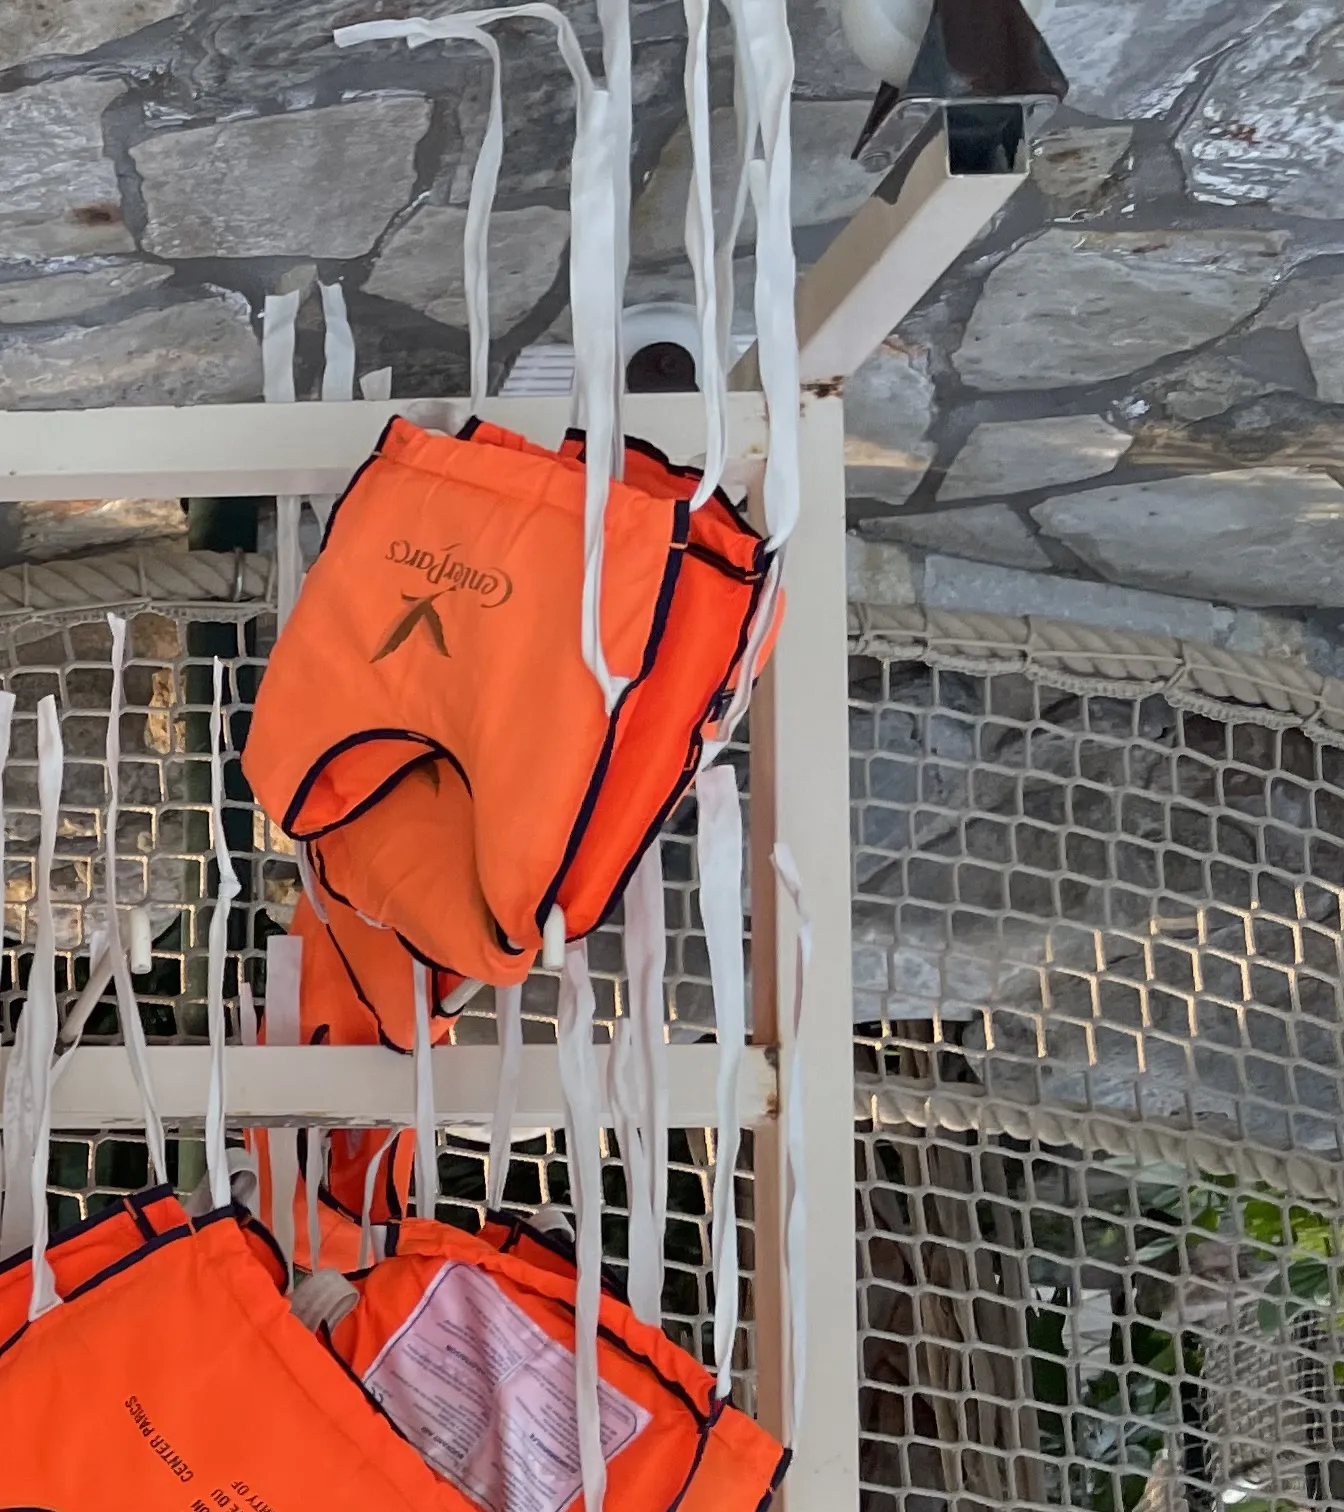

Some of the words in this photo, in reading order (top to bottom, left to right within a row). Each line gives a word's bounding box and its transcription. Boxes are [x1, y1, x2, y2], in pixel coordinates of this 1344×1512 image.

[125, 1395, 155, 1438] PARCS
[149, 1435, 194, 1483] CENTER
[210, 1488, 230, 1508] DU
[231, 1480, 250, 1496] OF
